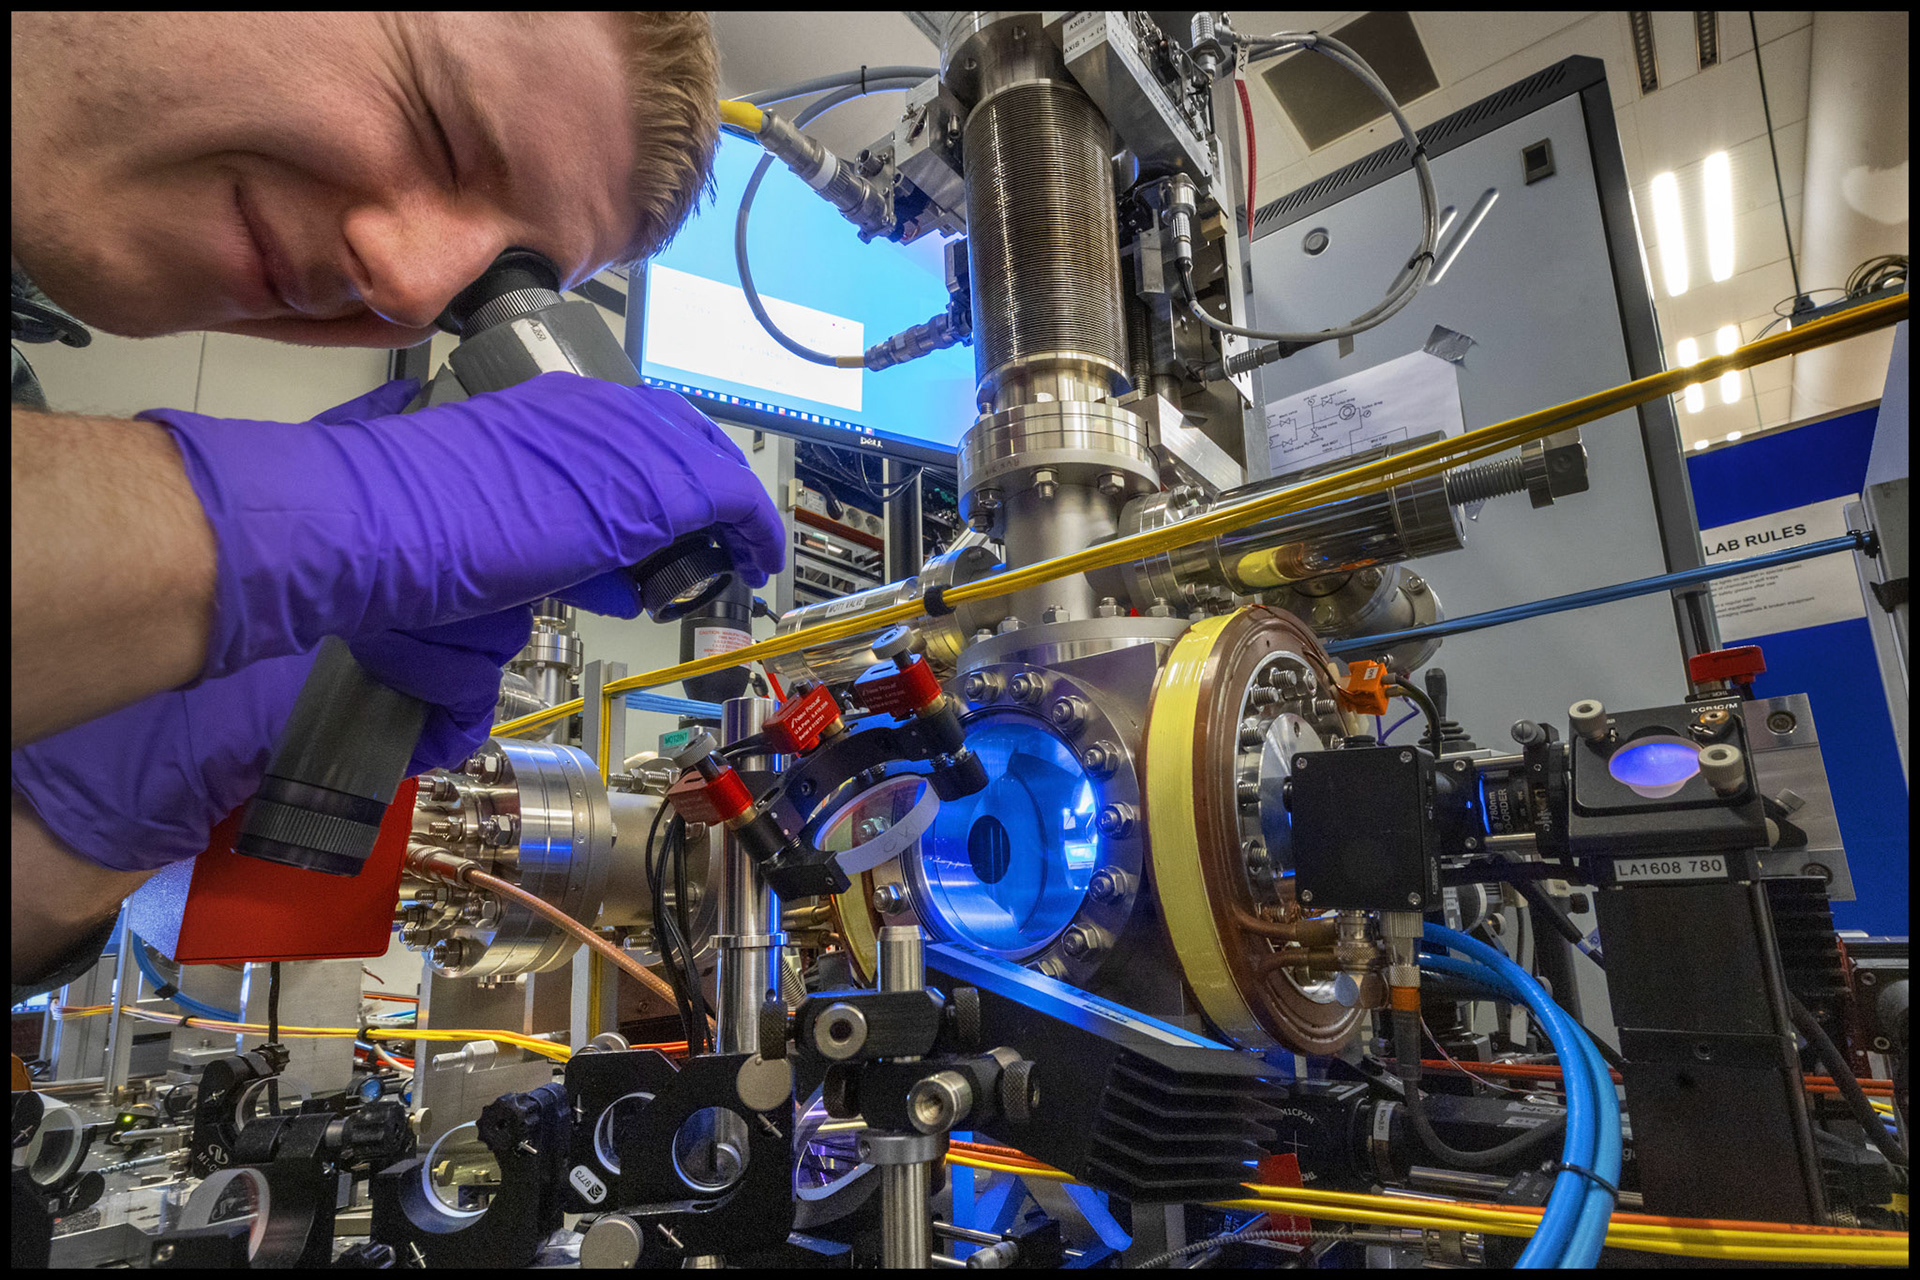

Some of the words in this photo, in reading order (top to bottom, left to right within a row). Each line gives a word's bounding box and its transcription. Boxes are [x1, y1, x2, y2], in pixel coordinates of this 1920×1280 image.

[1064, 41, 1080, 54] AXIS
[860, 436, 883, 448] DELL
[1705, 540, 1740, 556] LAB
[1745, 523, 1807, 547] RULES
[1489, 791, 1499, 821] 780nm
[1619, 861, 1681, 876] LA1608
[1688, 859, 1722, 872] 780
[575, 1170, 591, 1187] 9773
